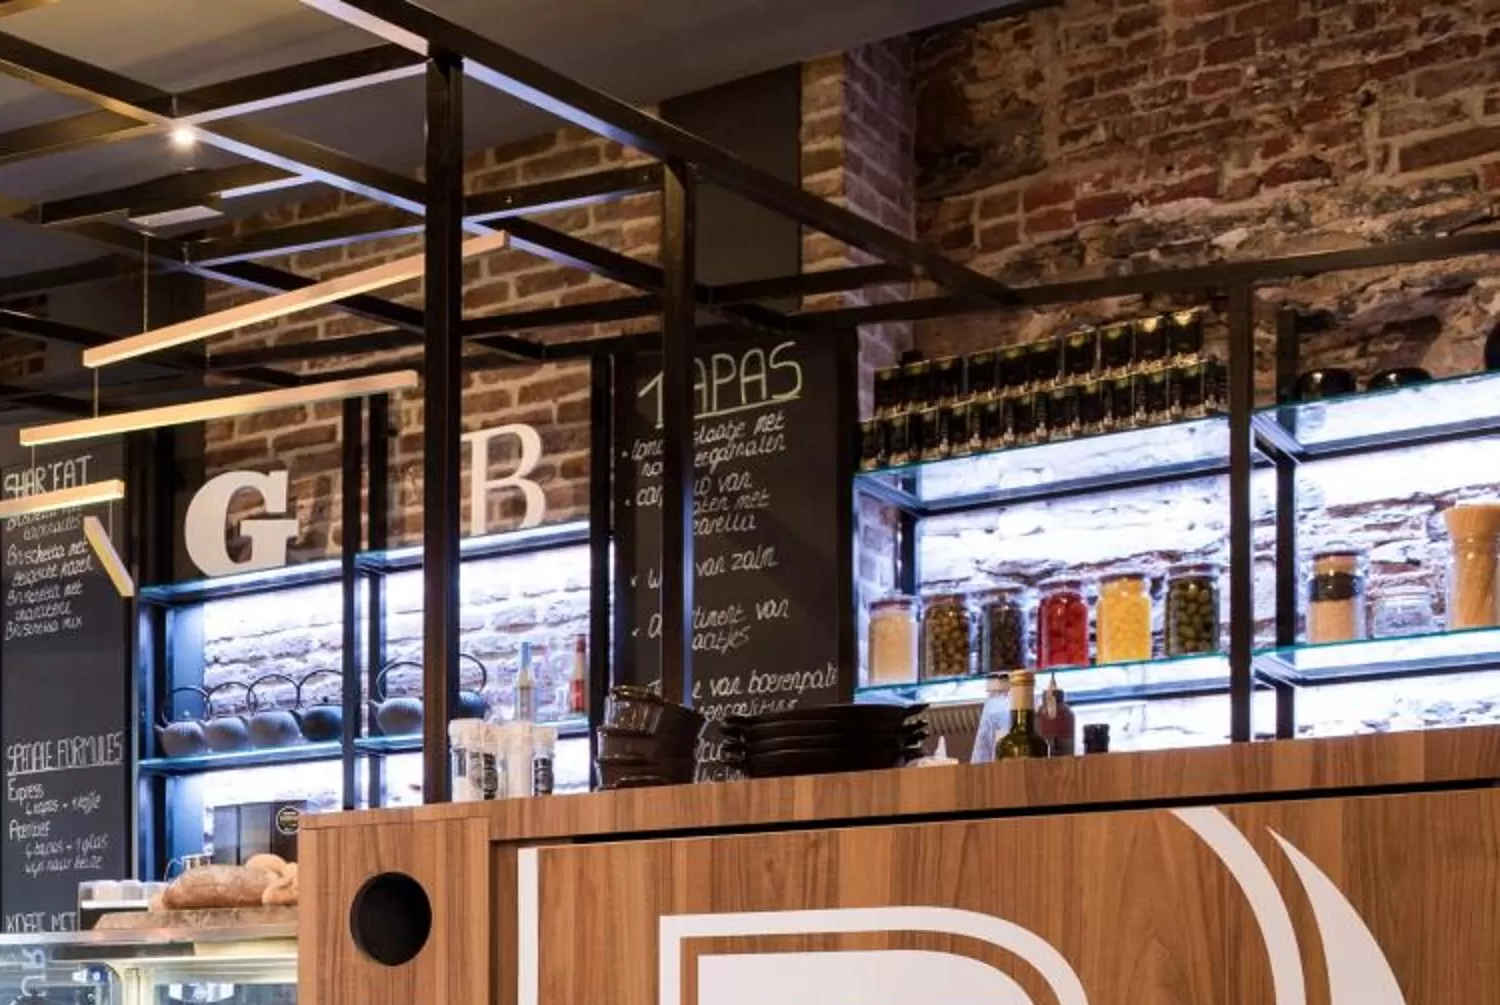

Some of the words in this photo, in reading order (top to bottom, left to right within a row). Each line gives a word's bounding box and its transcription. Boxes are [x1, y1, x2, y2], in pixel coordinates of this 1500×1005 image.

[461, 423, 546, 536] B
[717, 471, 752, 494] van
[185, 470, 298, 577] G
[755, 599, 790, 621] van
